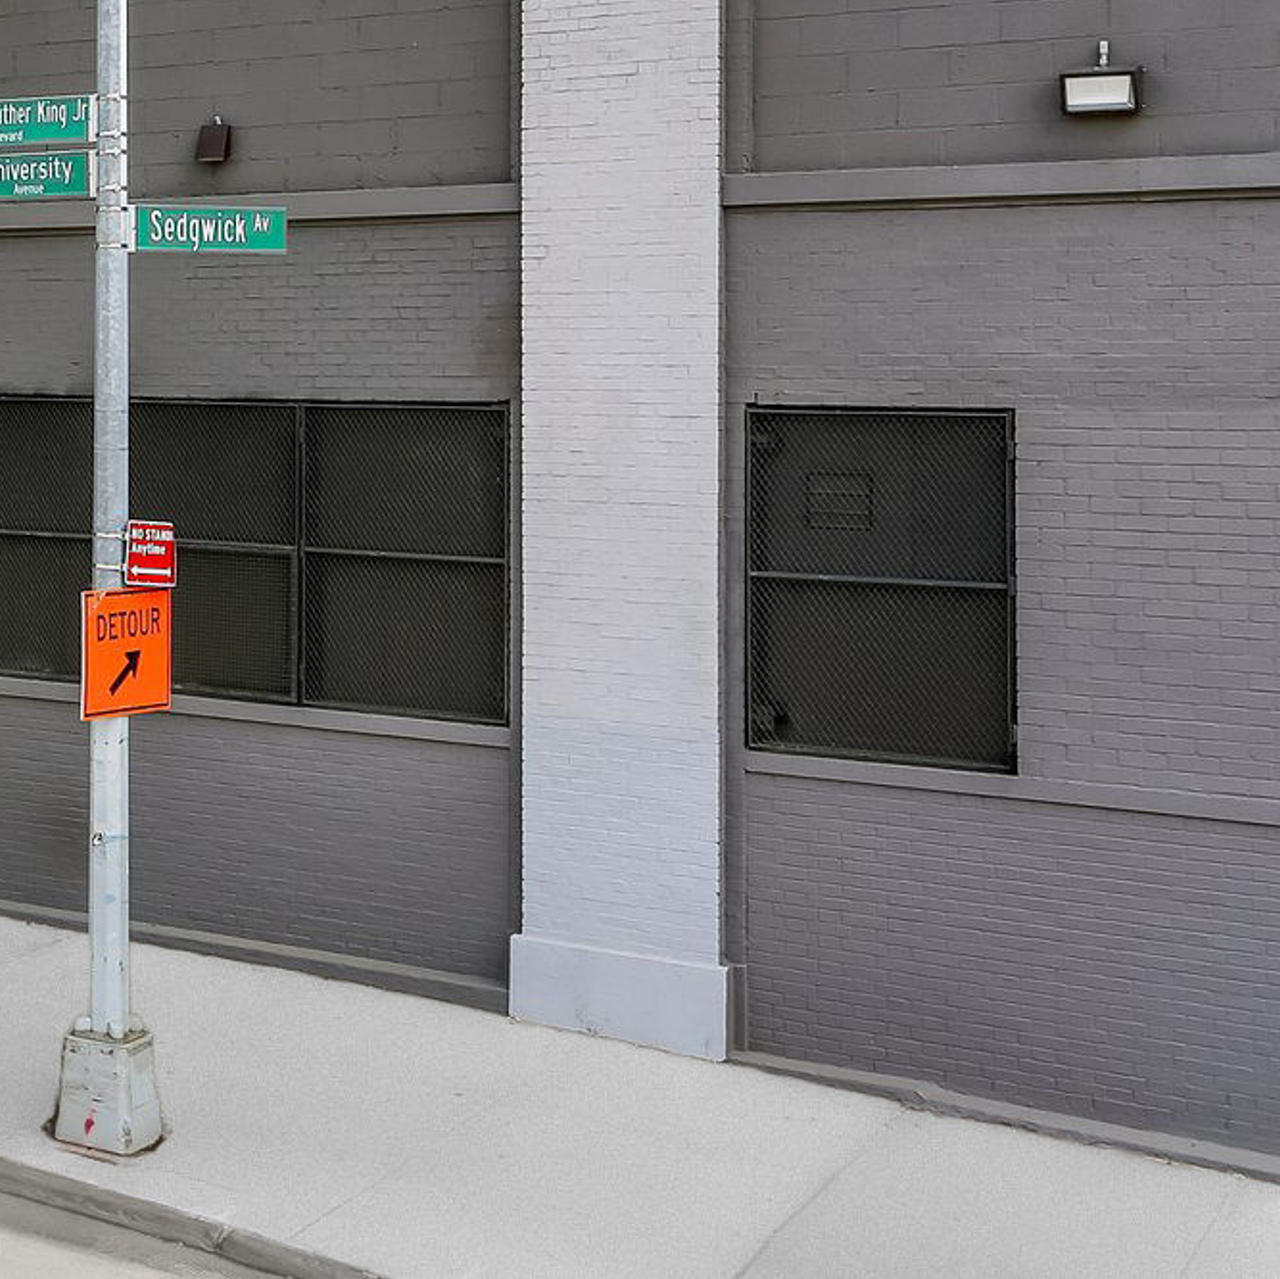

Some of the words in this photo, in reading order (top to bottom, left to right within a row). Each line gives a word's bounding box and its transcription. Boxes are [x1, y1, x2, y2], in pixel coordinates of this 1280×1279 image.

[37, 100, 67, 129] King
[72, 98, 88, 121] Jr
[13, 183, 46, 196] Avenue
[149, 211, 247, 251] Sedgwick
[253, 214, 270, 233] Av
[131, 528, 144, 539] NO
[131, 542, 166, 556] Anytime
[96, 607, 161, 642] DETOUR
